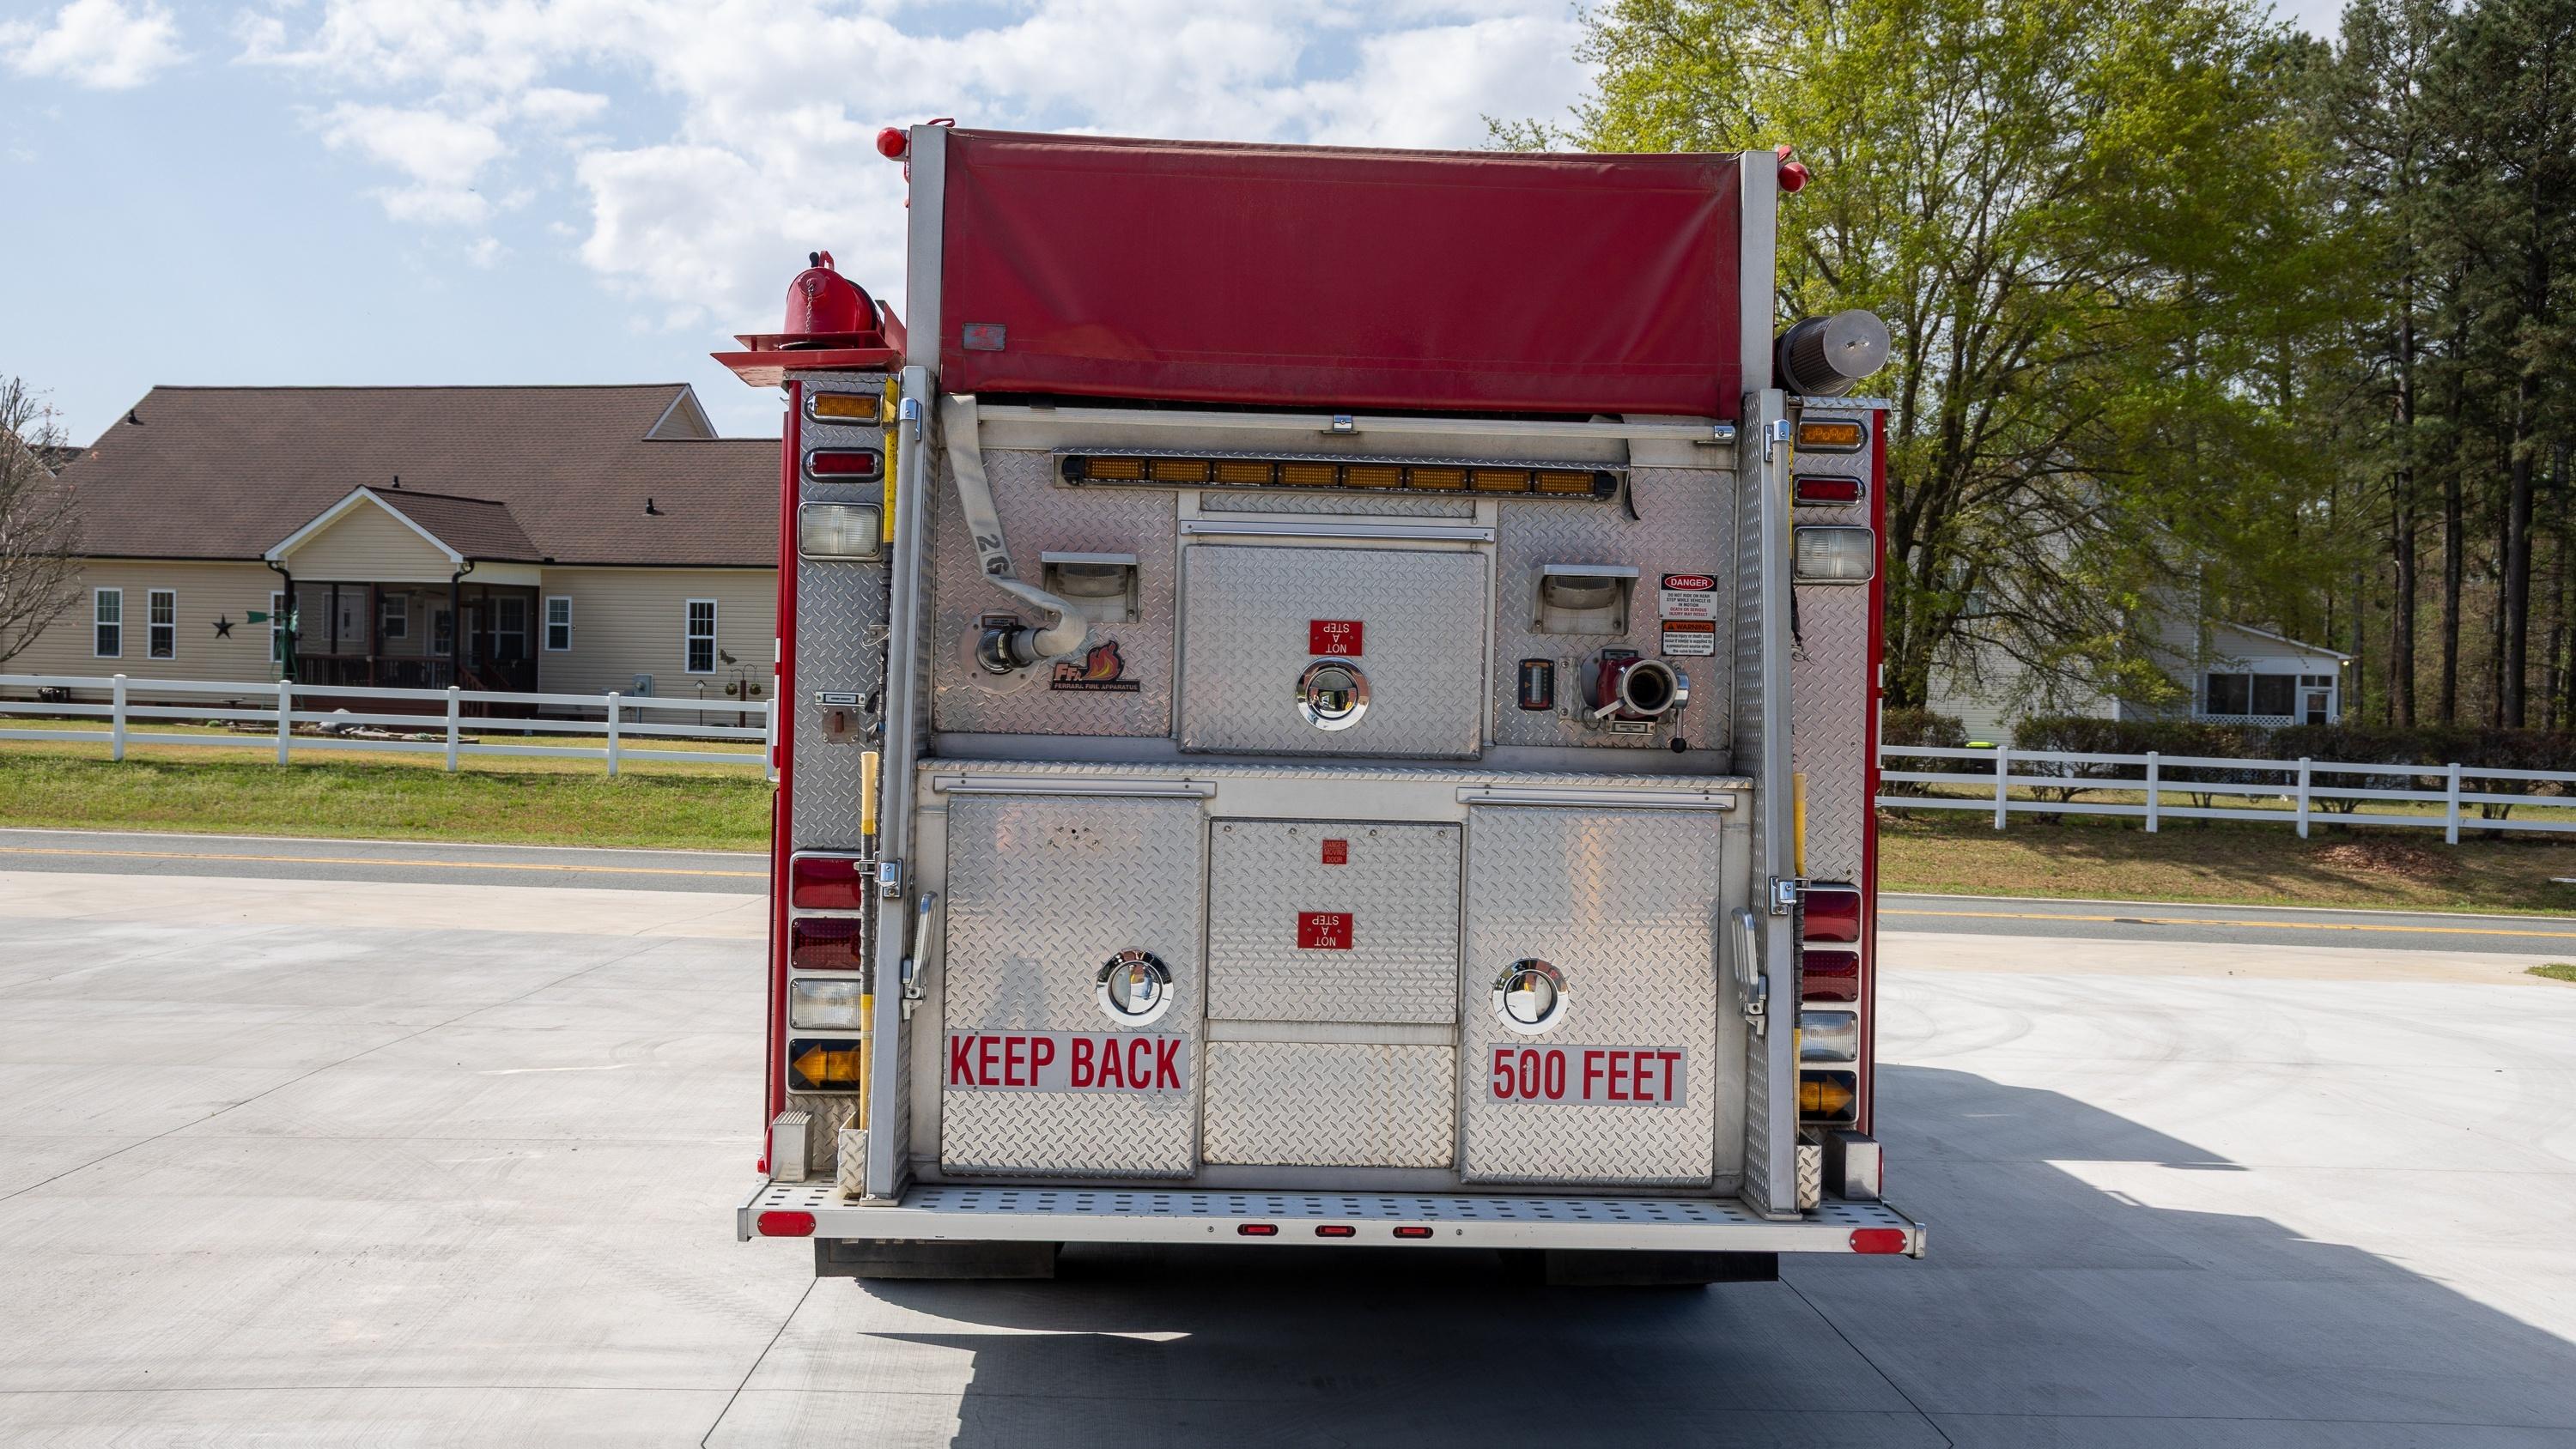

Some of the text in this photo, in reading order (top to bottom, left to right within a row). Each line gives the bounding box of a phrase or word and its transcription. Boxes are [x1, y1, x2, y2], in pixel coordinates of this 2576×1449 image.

[1671, 579, 1708, 587] DANGER
[1323, 623, 1350, 634] STEP
[1333, 634, 1340, 643] A
[1326, 644, 1346, 653] NOT
[1312, 915, 1339, 925] STEP
[1321, 926, 1329, 936] A
[1314, 937, 1336, 946] NOT
[950, 1035, 1182, 1090] KEEP BACK
[1492, 1049, 1681, 1101] 500 FEET
